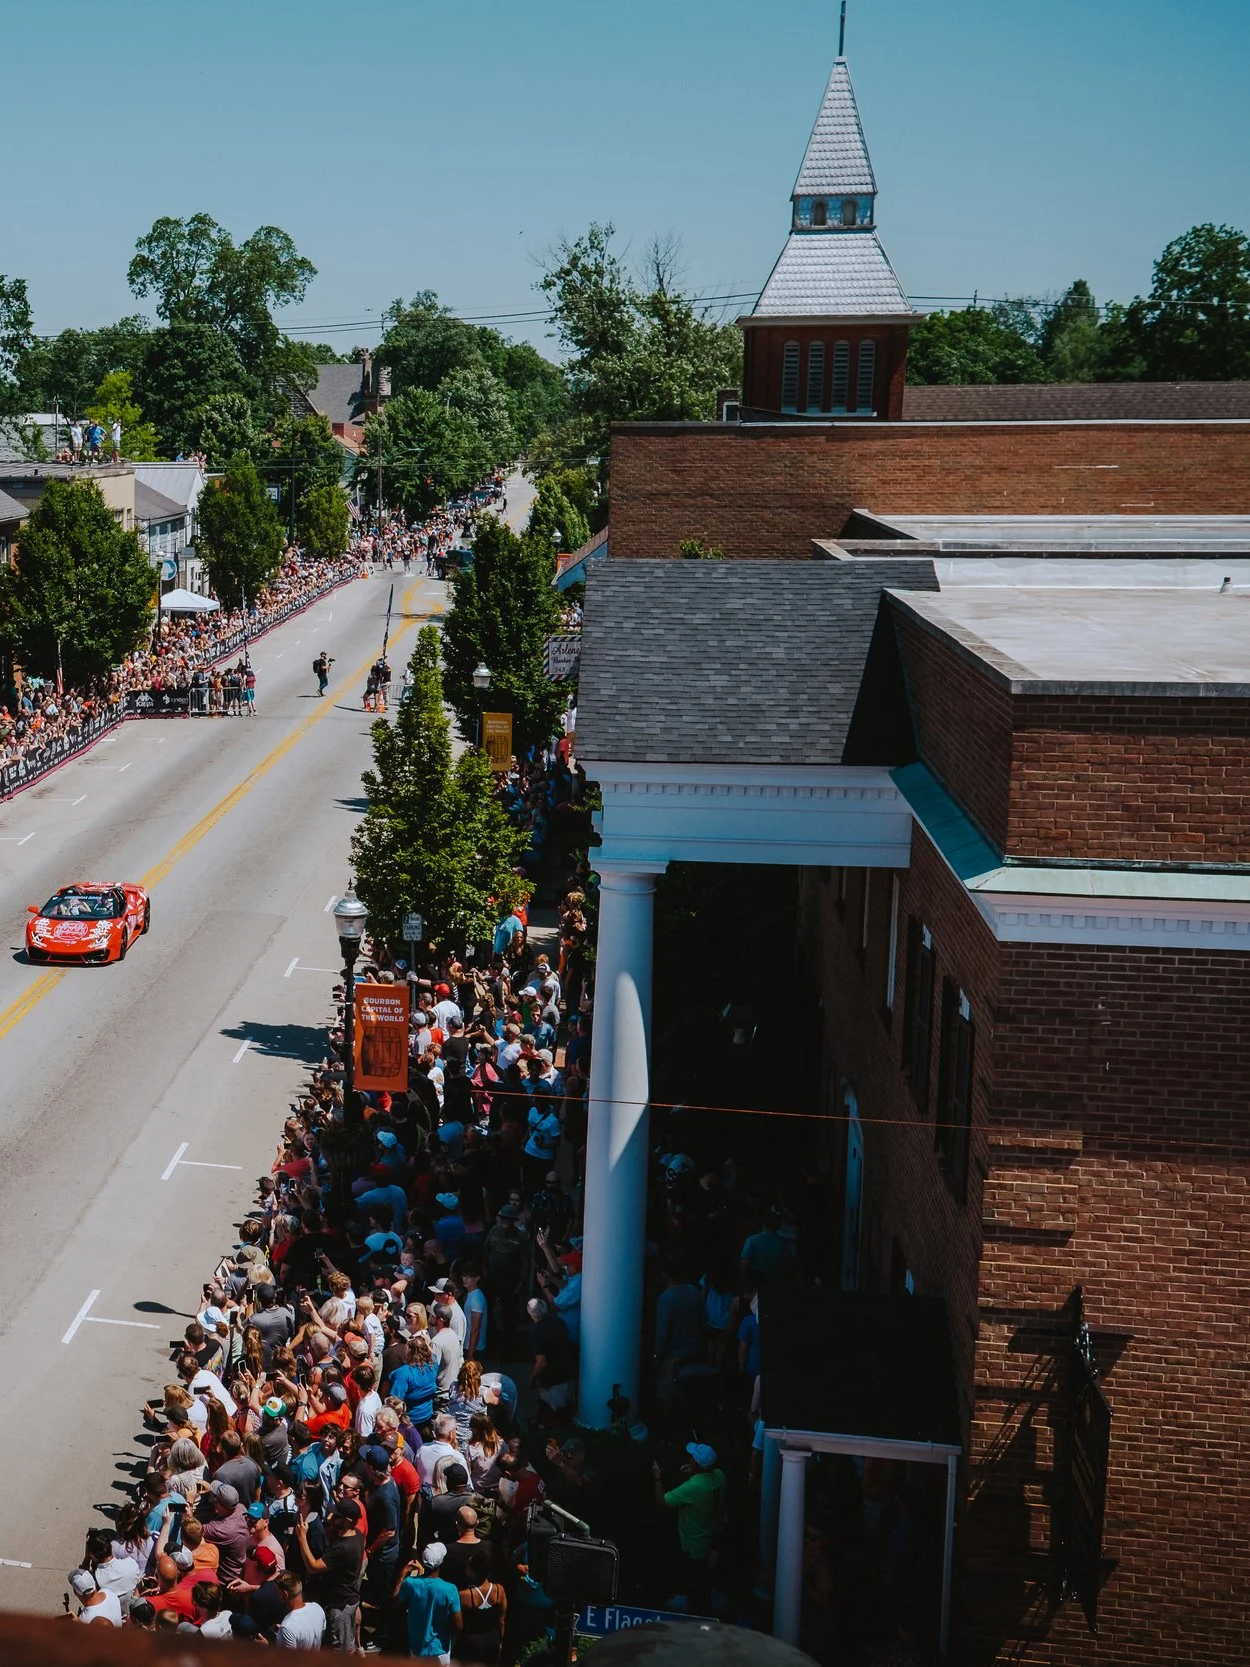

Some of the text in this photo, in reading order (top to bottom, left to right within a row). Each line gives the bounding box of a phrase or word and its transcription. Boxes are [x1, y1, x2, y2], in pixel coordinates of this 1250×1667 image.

[364, 997, 401, 1005] BOURBON
[377, 1014, 404, 1022] WORLD
[586, 1605, 597, 1627] E
